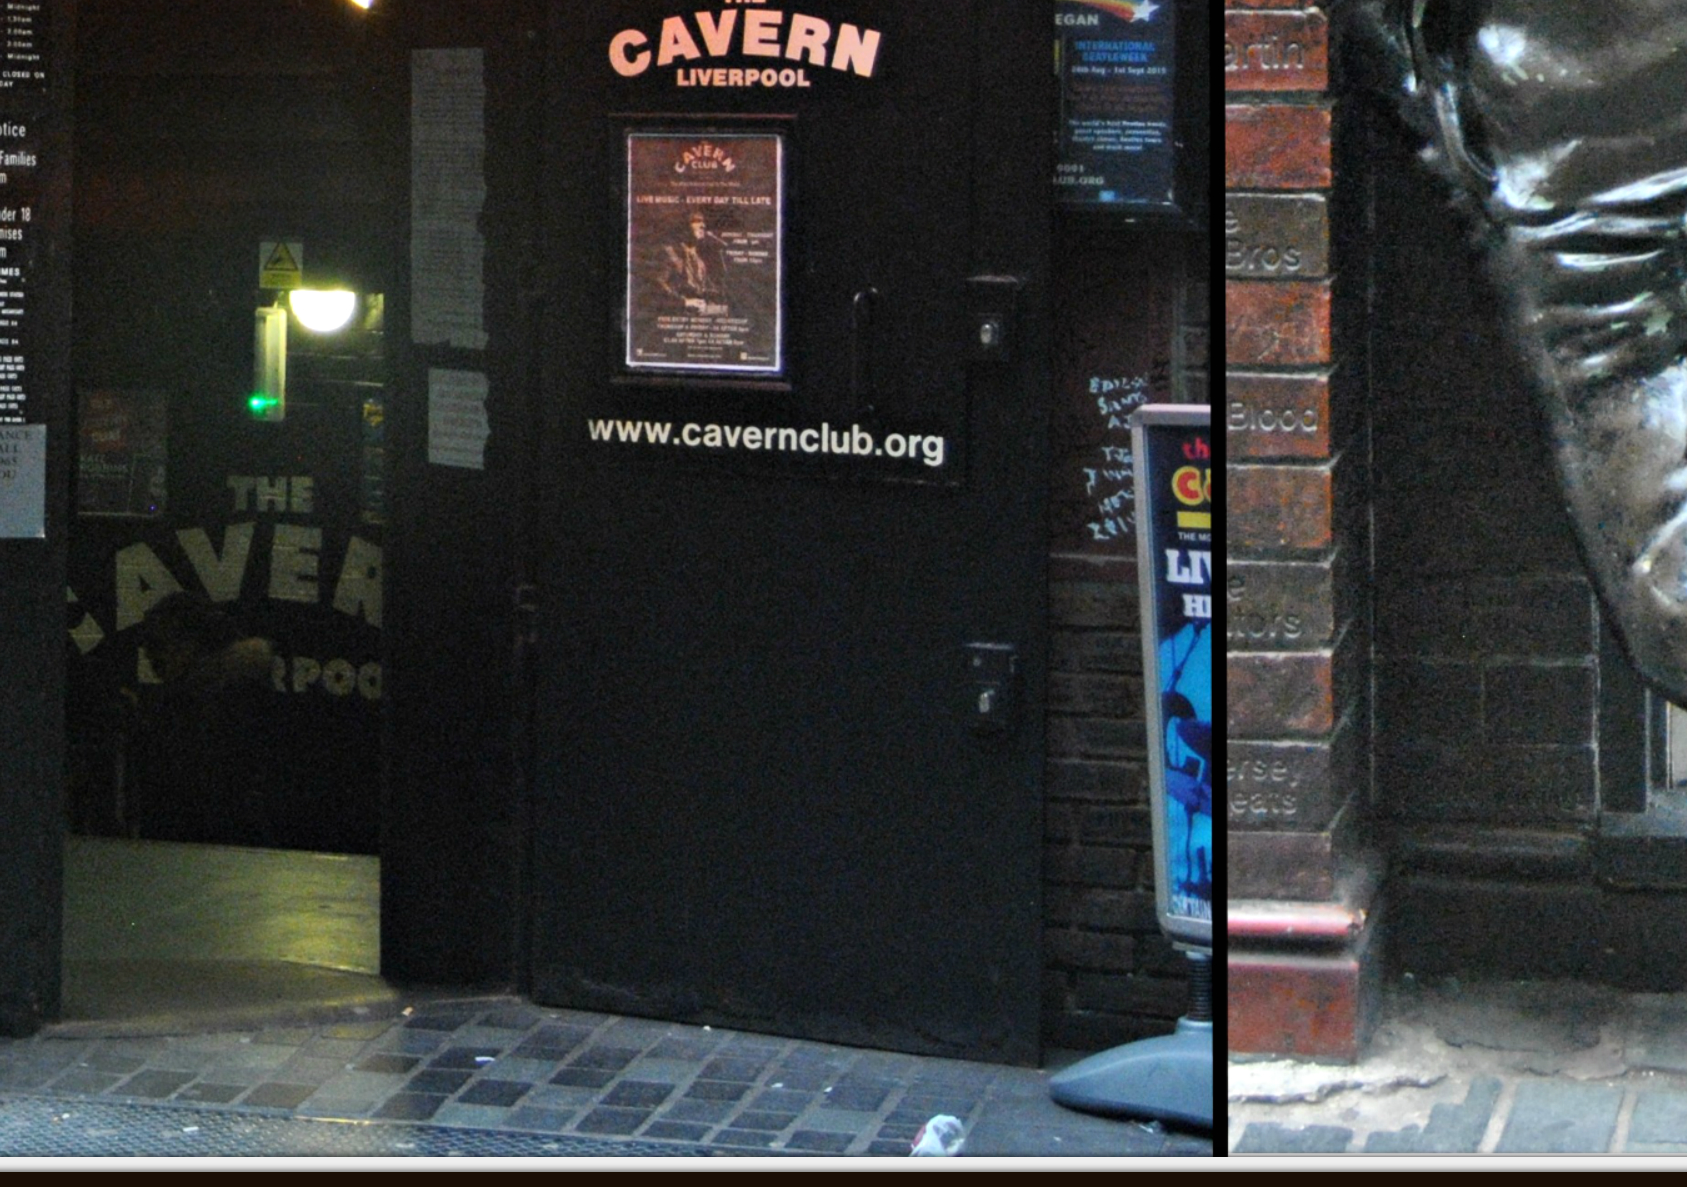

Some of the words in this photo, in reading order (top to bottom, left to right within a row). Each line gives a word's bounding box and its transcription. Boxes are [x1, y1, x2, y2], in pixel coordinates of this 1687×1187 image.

[608, 8, 881, 78] CAVERN
[1075, 41, 1156, 52] INTERNATIONAL
[677, 67, 811, 87] LIVERPOOL
[673, 144, 736, 174] CAVERN
[691, 160, 719, 169] CLUB
[636, 195, 653, 204] LIVE
[20, 207, 32, 222] 18
[1226, 402, 1318, 433] Blood
[588, 415, 945, 466] www.cavernclub.org
[227, 475, 314, 513] THE
[1178, 532, 1196, 541] THE
